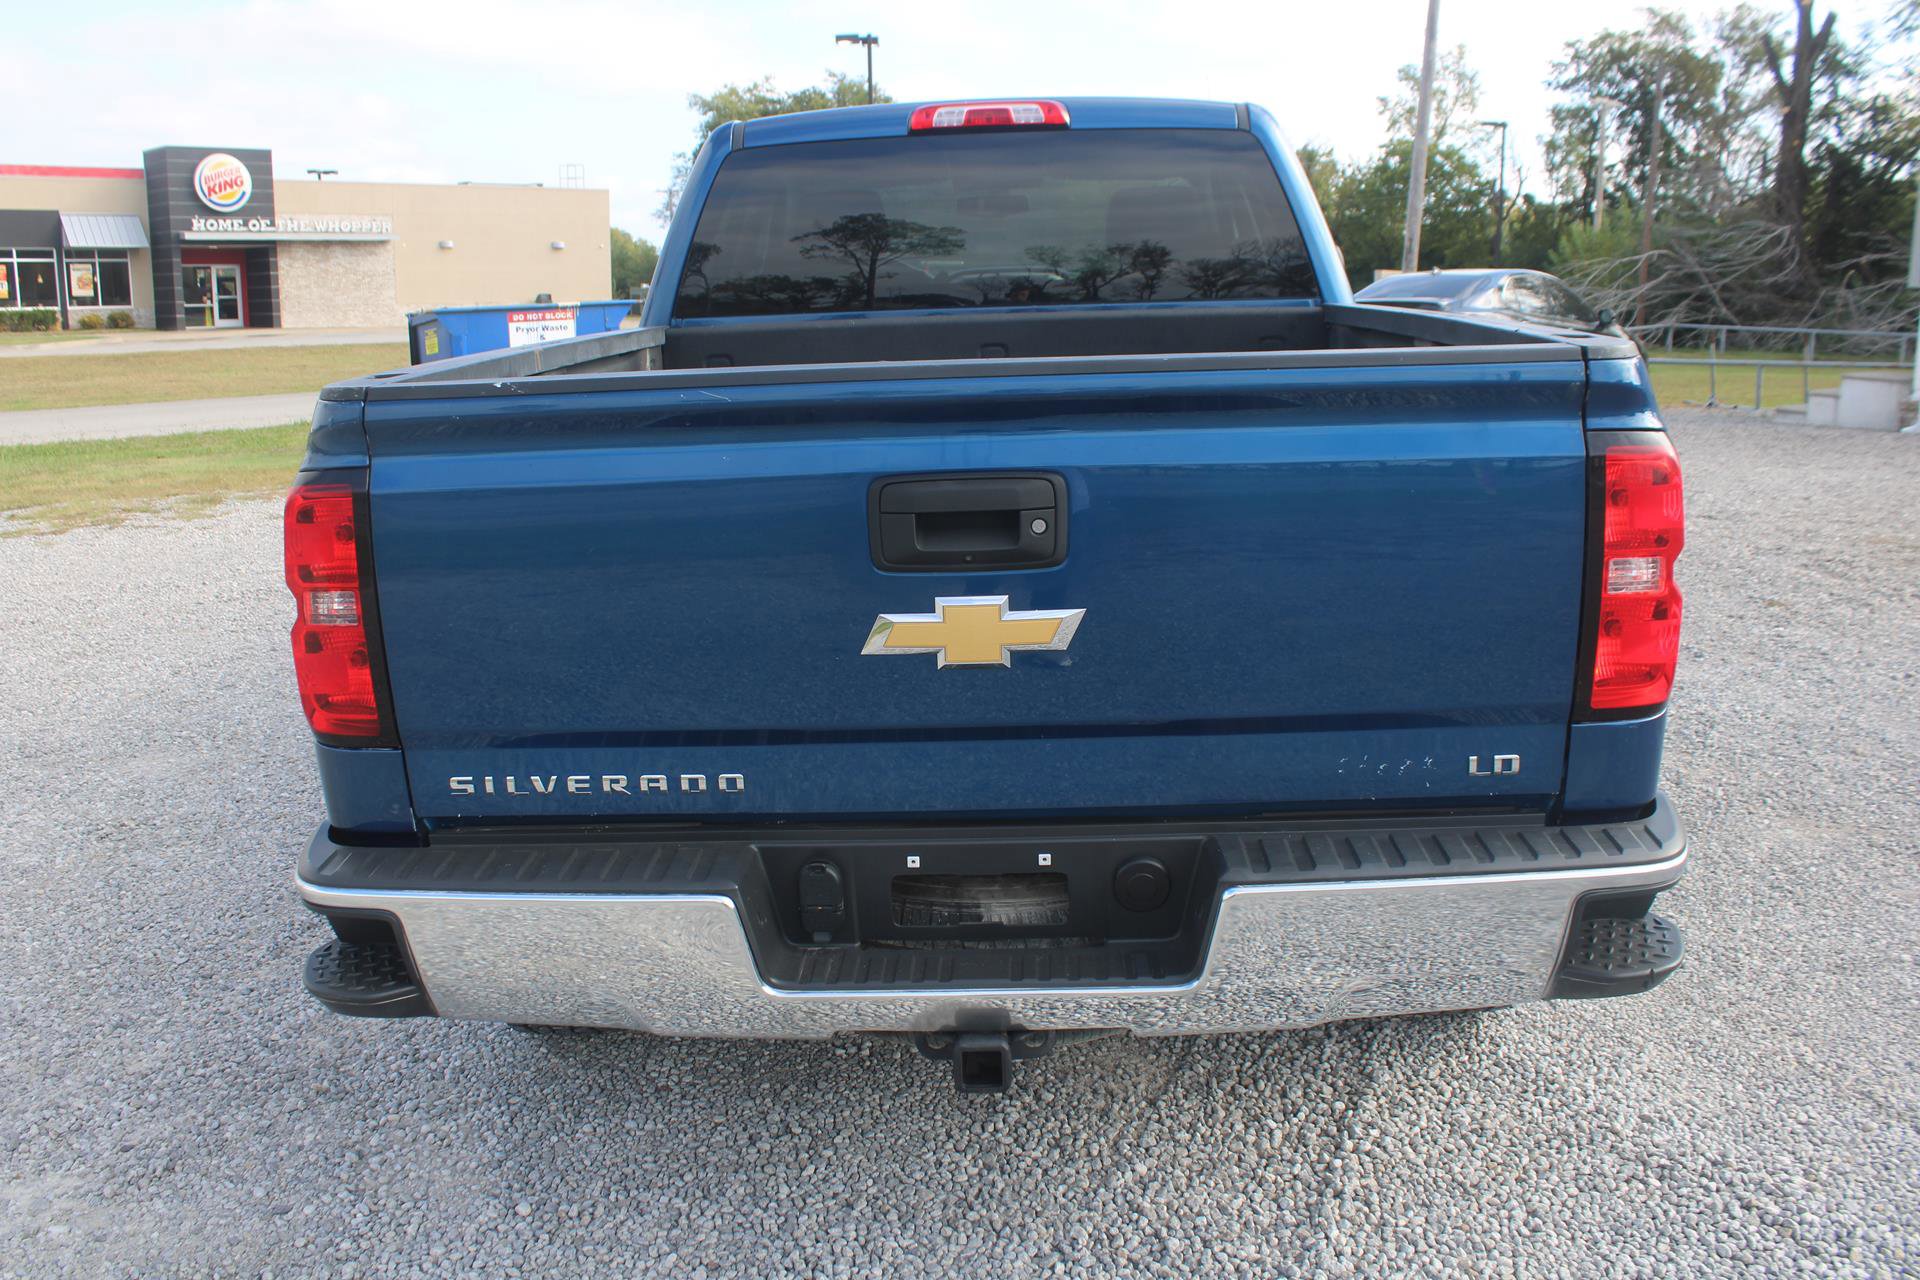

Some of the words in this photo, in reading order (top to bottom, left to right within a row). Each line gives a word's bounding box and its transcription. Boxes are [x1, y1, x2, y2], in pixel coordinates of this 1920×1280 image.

[204, 167, 242, 185] BURGER
[207, 176, 244, 197] KING
[192, 217, 243, 231] HOME
[248, 218, 271, 231] OF
[277, 218, 309, 232] THE
[313, 218, 392, 232] WHOPPER
[527, 313, 543, 321] NOT
[516, 325, 539, 334] Pryor
[541, 324, 568, 332] Waste
[1468, 754, 1520, 776] LD
[449, 773, 745, 795] SILVERADO
